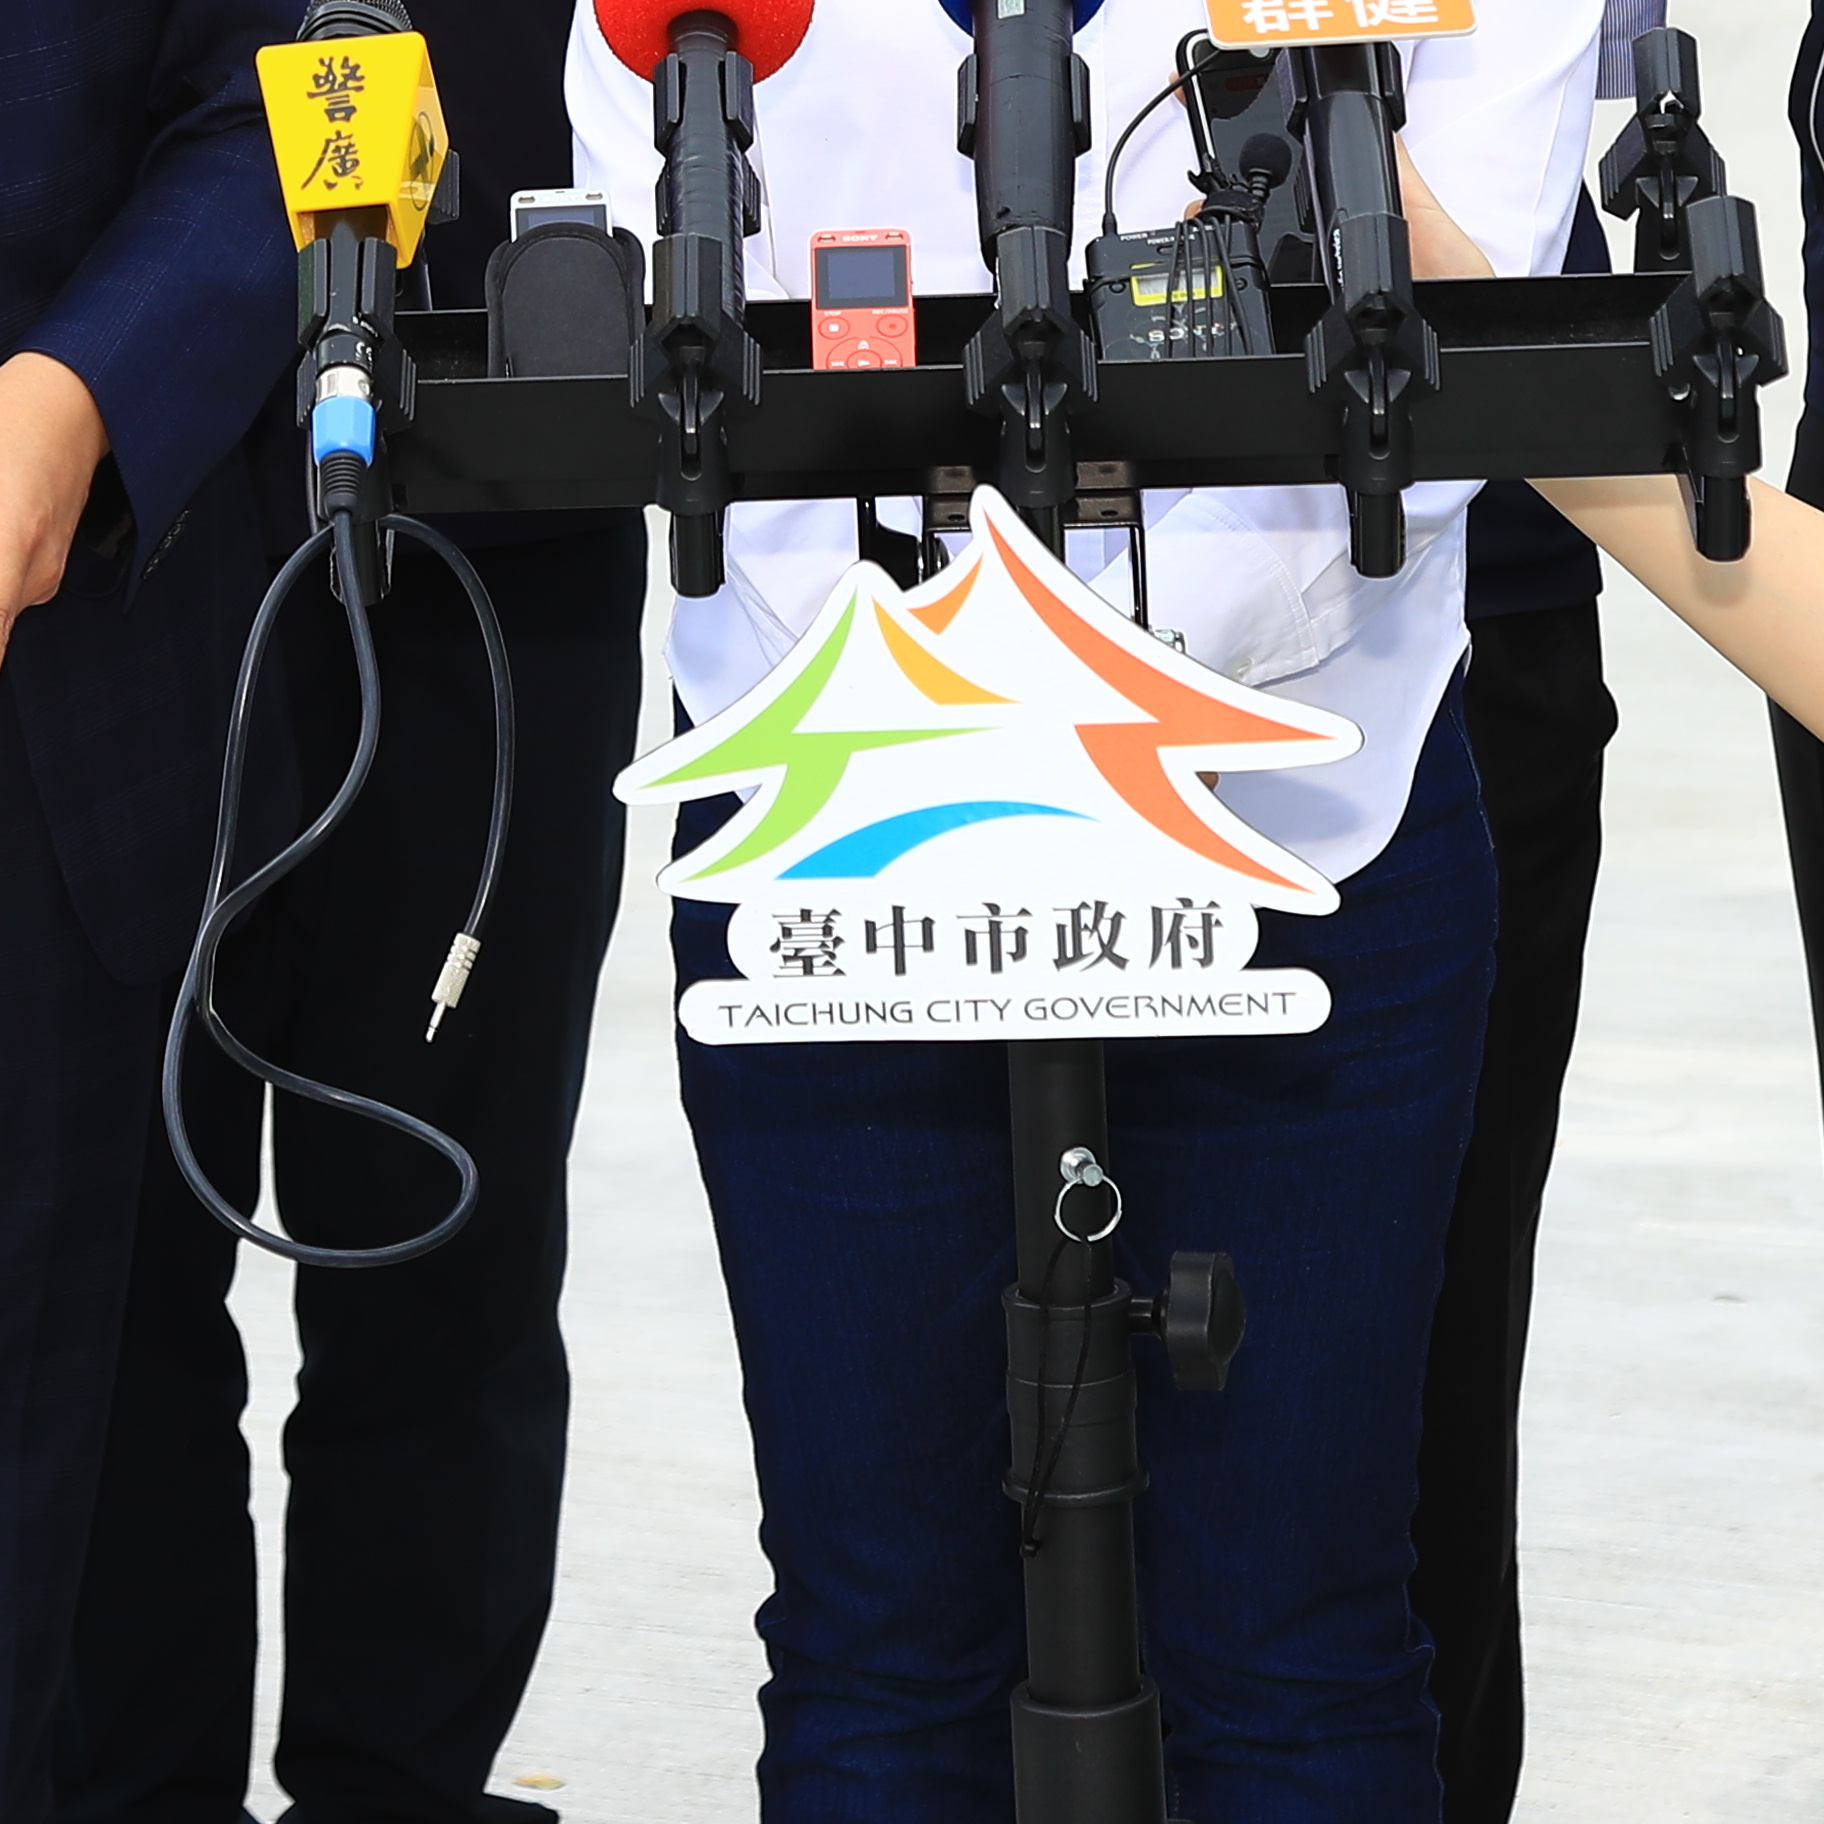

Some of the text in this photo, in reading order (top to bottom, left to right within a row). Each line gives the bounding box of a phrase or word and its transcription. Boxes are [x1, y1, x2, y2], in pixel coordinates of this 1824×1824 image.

[301, 54, 366, 192] 警廣
[842, 234, 878, 242] SONY
[768, 896, 1224, 979] 臺中市政府
[718, 991, 1297, 1028] TAICHUNG CITY GOVERNMENT
